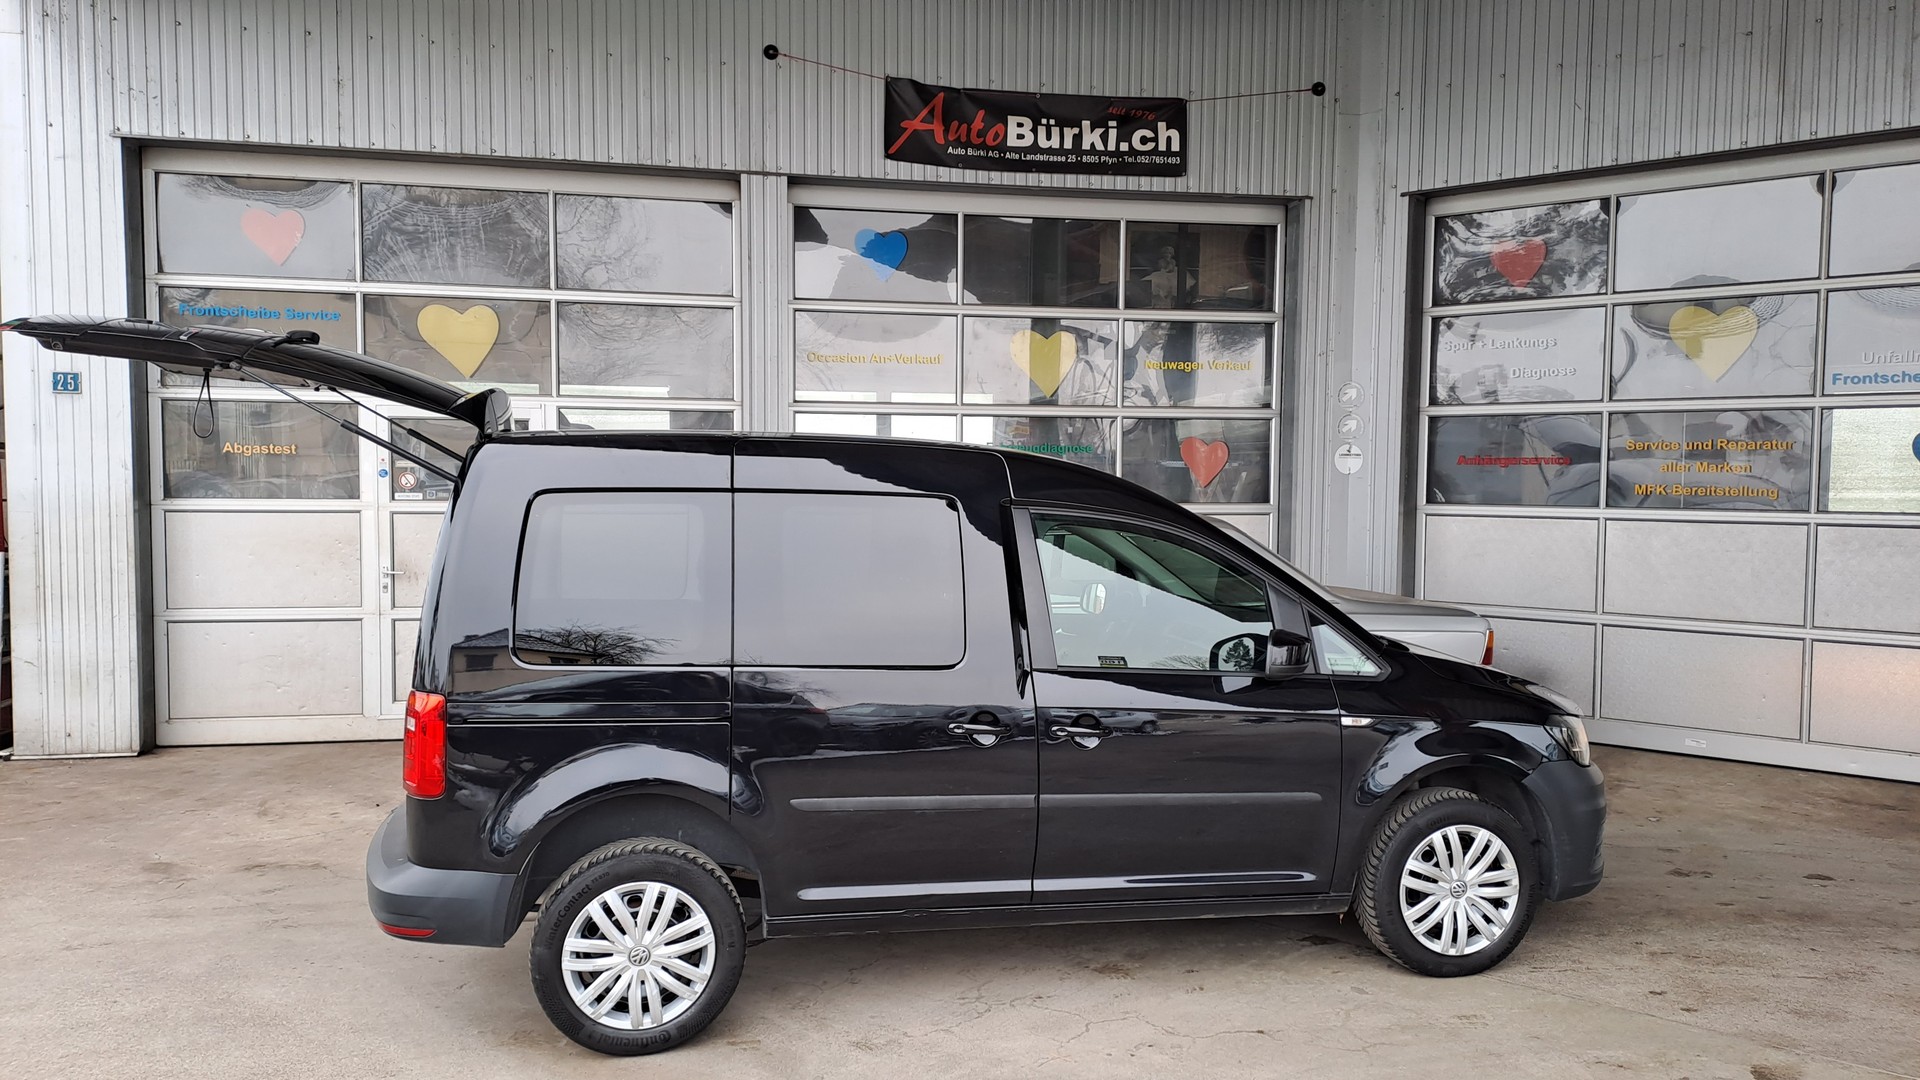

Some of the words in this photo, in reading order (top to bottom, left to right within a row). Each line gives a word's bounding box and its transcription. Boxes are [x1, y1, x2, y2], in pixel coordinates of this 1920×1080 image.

[1130, 109, 1157, 121] 1976
[947, 146, 966, 155] Auto
[967, 147, 987, 157] Bürki
[987, 150, 999, 158] AG
[1005, 151, 1020, 160] Alte
[1021, 152, 1066, 162] Landstrasse
[1067, 154, 1077, 163] 25
[1082, 155, 1100, 163] 8505
[1100, 156, 1118, 165] Pfyn
[179, 303, 280, 319] Frontscheibe
[284, 307, 341, 321] Service
[1444, 340, 1475, 353] Spur
[1489, 338, 1557, 351] Lenkungs
[806, 352, 866, 364] Occasion
[1145, 360, 1203, 373] Neuwagen
[1208, 360, 1252, 371] Verkauf
[1510, 366, 1577, 380] Diagnose
[57, 374, 75, 390] 25
[1832, 371, 1920, 386] Frontsche
[222, 441, 298, 457] Abgastest
[1625, 439, 1680, 451] Service
[1684, 438, 1714, 451] und
[1717, 438, 1797, 452] Reparatur
[1456, 454, 1573, 468] Anhängerservice
[1659, 462, 1693, 473] aller
[1696, 462, 1754, 474] Marken
[1634, 484, 1779, 500] MFK-Bereitstellung
